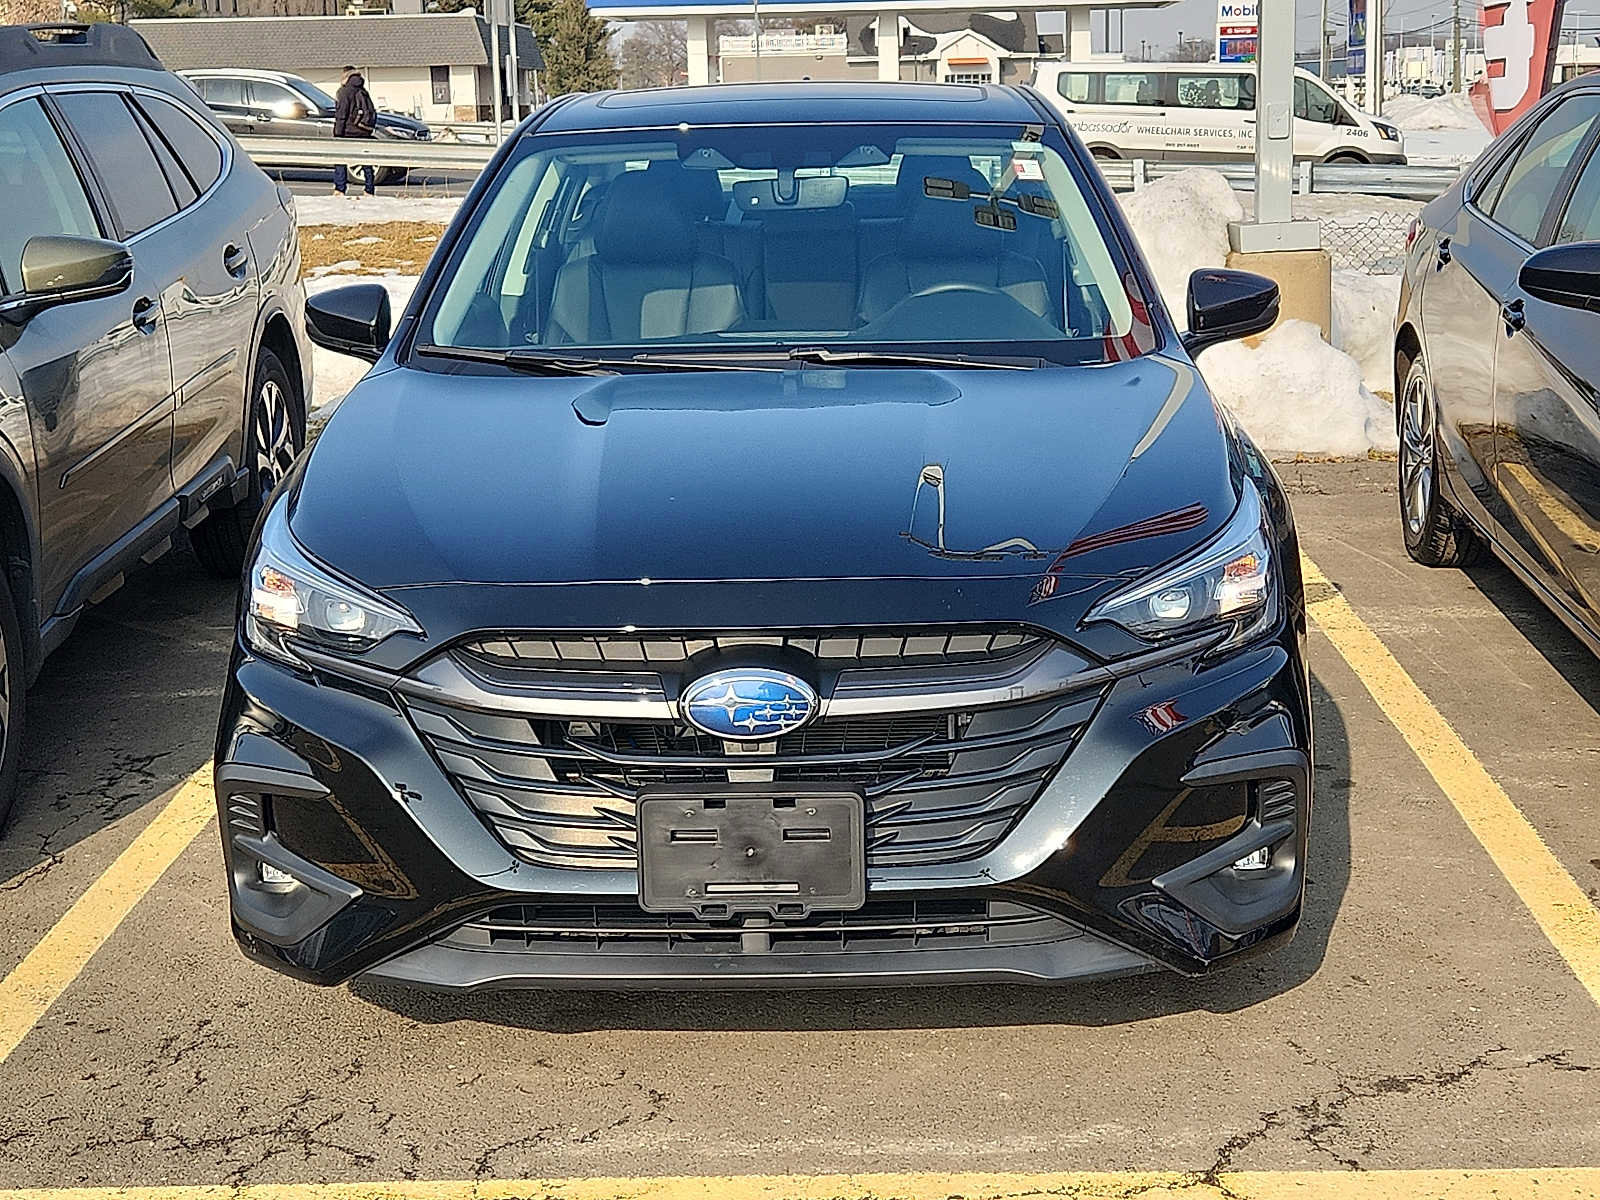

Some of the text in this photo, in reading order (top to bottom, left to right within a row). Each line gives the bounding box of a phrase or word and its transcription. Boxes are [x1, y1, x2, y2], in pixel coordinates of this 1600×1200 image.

[1221, 4, 1259, 17] Mobil
[1136, 126, 1191, 136] WHEELCHAIR
[1193, 128, 1236, 139] SERVICES,
[1346, 128, 1369, 138] 2406
